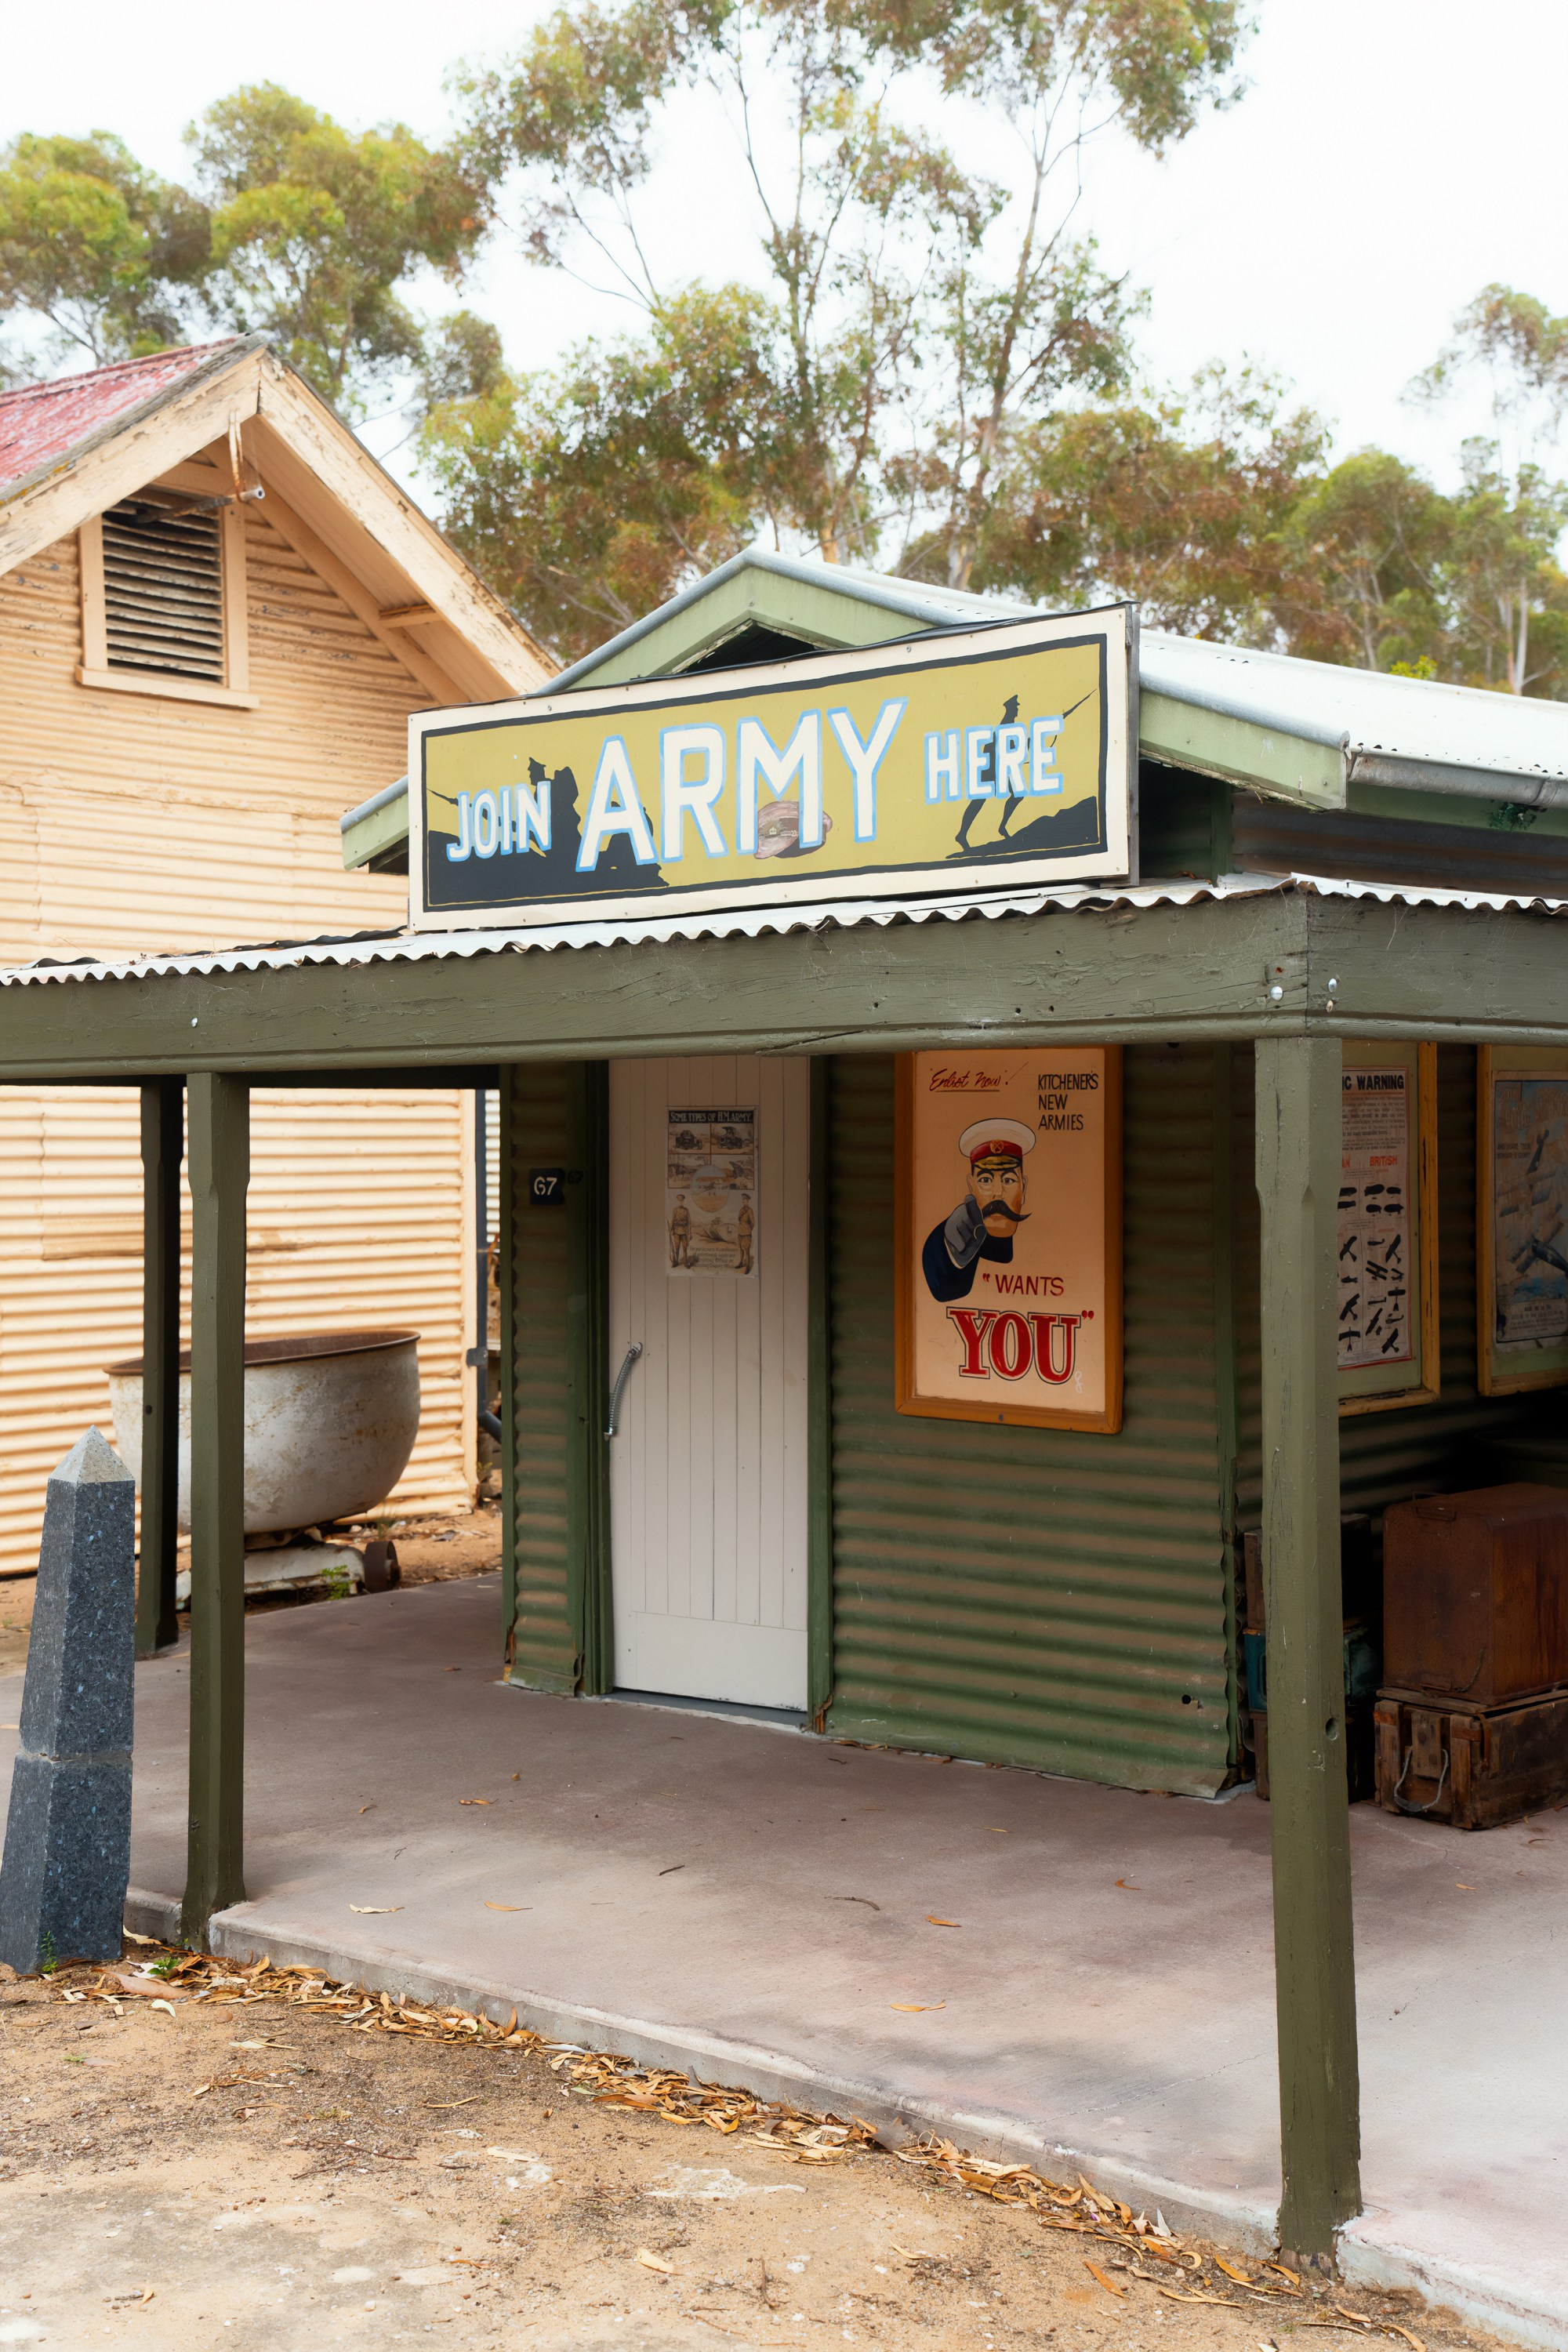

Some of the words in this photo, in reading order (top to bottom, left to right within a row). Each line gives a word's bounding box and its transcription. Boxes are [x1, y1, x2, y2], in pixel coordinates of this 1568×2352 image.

[446, 781, 552, 862] JOIN
[575, 697, 908, 873] ARMY
[924, 714, 1064, 805] HERE
[1356, 1075, 1405, 1091] WARNING
[1038, 1094, 1069, 1110] NEW
[1038, 1114, 1084, 1131] ARMIES
[1370, 1156, 1398, 1167] BRITISH
